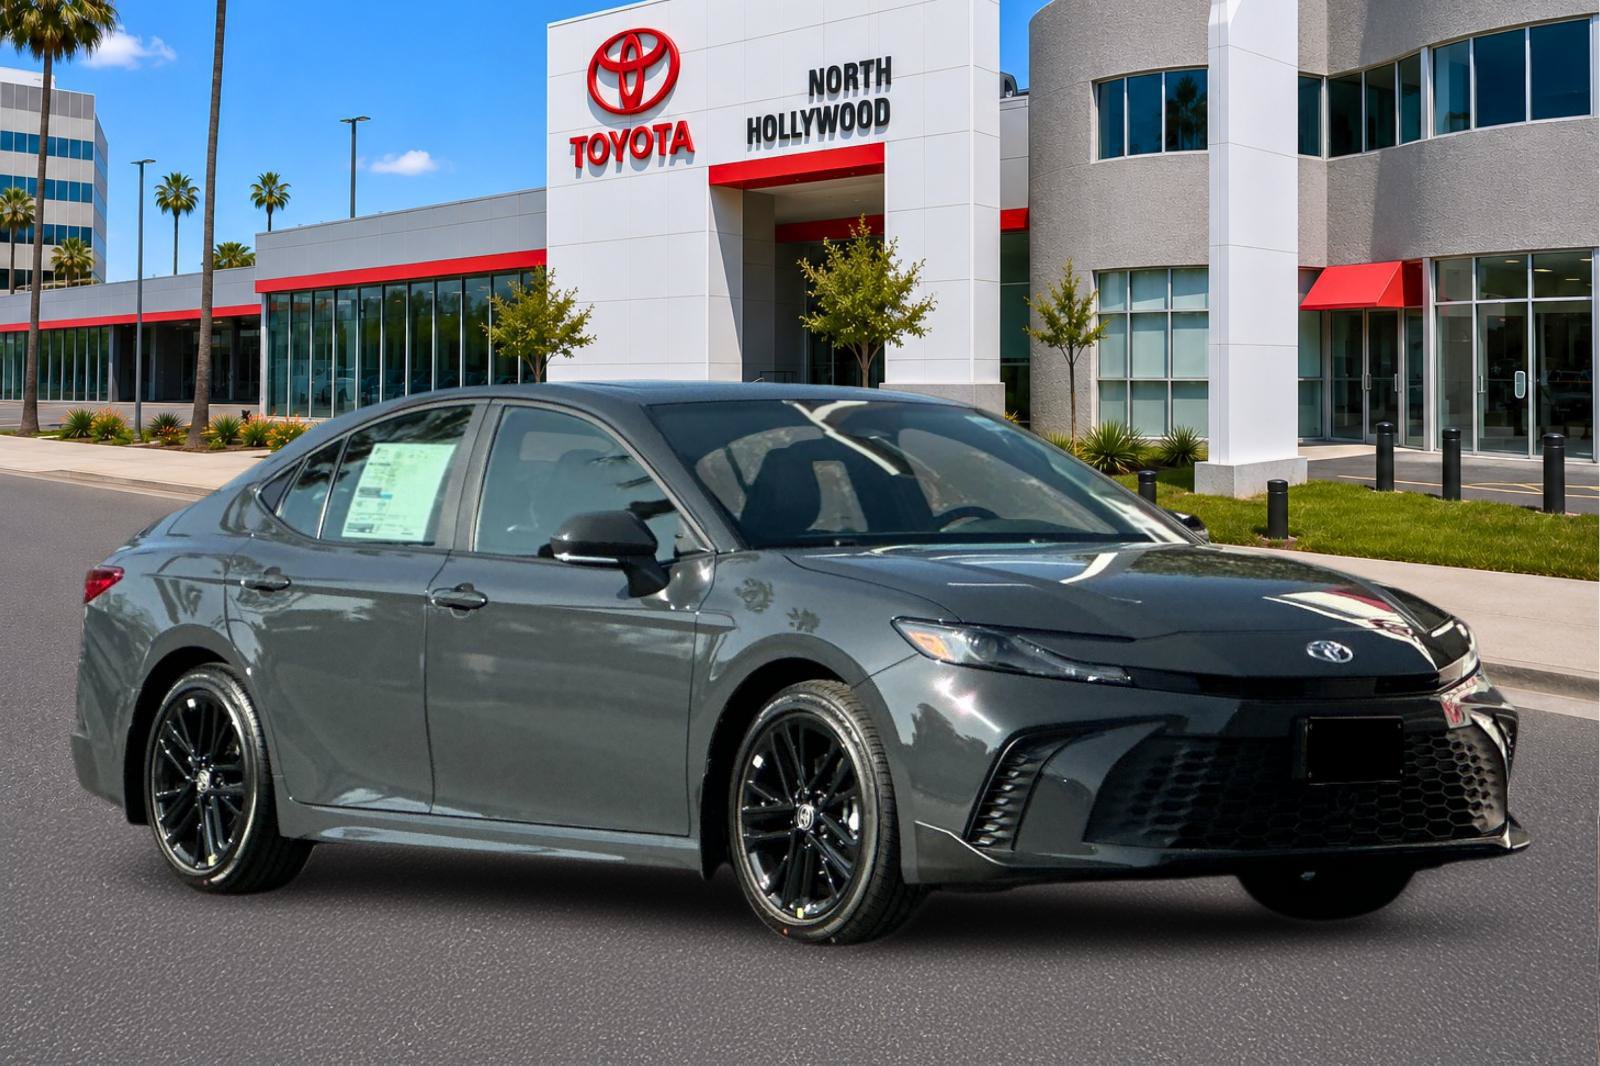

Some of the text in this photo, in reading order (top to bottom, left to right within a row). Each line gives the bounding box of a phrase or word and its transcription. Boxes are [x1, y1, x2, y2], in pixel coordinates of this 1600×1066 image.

[808, 56, 892, 96] NORTH
[569, 120, 694, 168] TOYOTA
[747, 97, 891, 145] HOLLYWOOD
